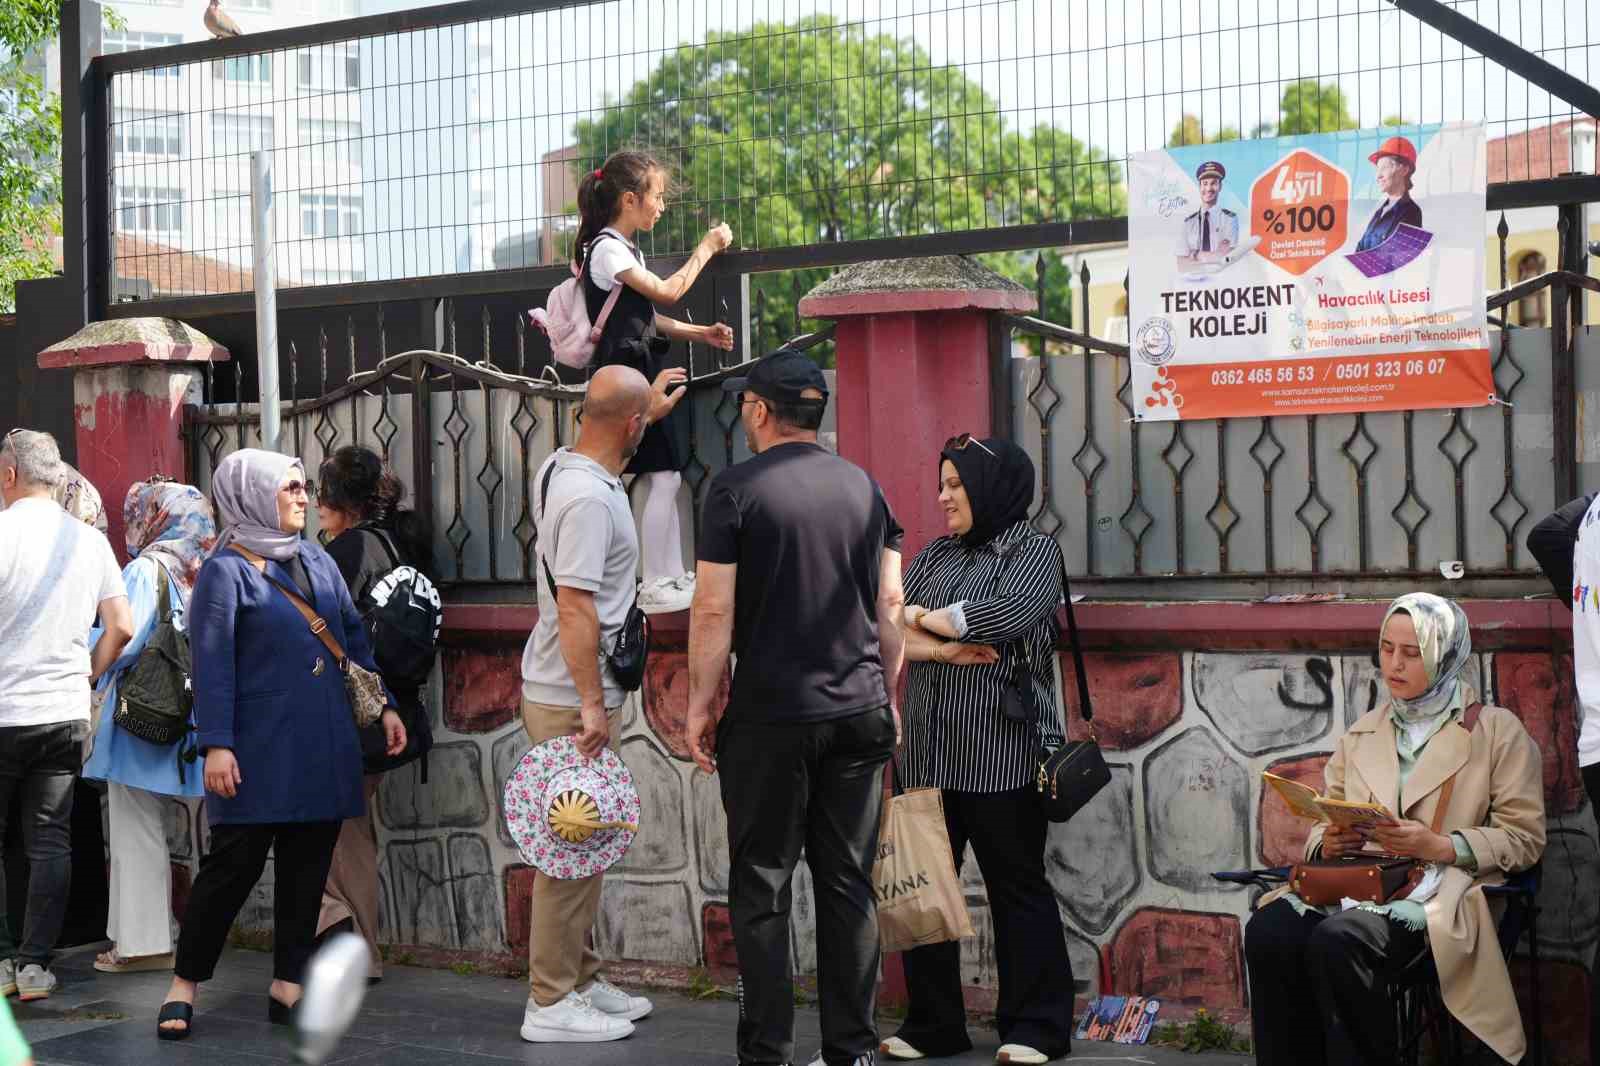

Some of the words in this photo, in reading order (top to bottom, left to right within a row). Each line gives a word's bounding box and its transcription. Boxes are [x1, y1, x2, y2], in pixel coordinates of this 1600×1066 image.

[1271, 165, 1296, 205] 4
[1263, 206, 1334, 235] %100
[1161, 284, 1295, 313] TEKNOKENT
[1318, 290, 1386, 308] Havacılık
[1389, 287, 1430, 304] Lisesi
[1307, 332, 1377, 348] Yenilenebilir
[1380, 331, 1412, 345] Enerji
[1415, 327, 1482, 342] Teknolojileri
[1211, 370, 1244, 386] 0362
[1248, 368, 1272, 384] 465
[1298, 366, 1314, 382] 53
[1336, 363, 1370, 379] 0501
[1376, 361, 1401, 377] 323
[1405, 360, 1423, 376] 06
[1428, 358, 1446, 375] 07
